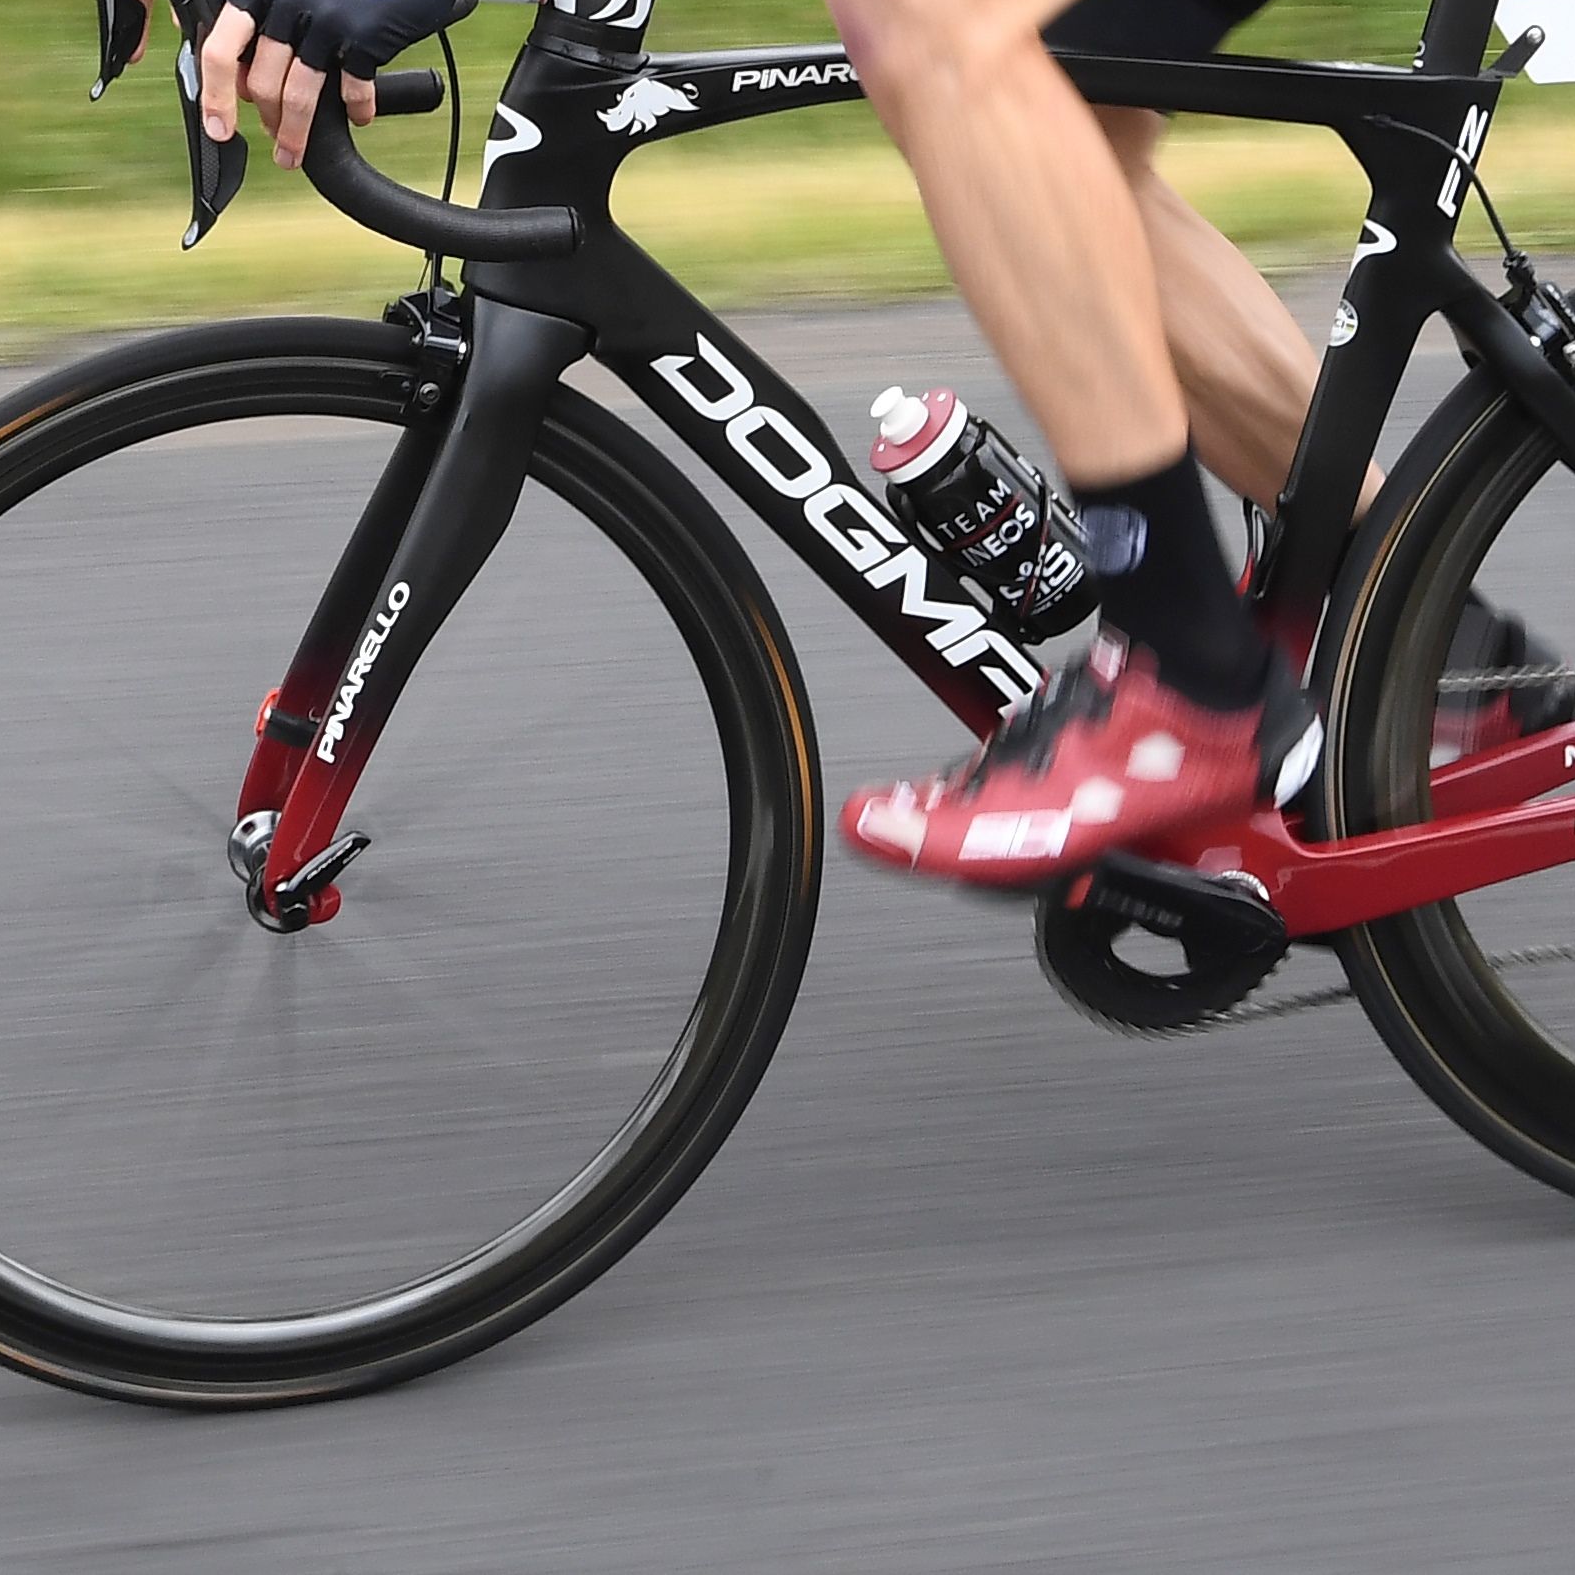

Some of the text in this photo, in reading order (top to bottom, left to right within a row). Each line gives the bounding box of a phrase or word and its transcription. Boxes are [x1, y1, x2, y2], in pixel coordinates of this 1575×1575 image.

[936, 477, 1013, 541] TEAM
[960, 502, 1036, 568] INEOS
[316, 580, 411, 765] PINARELLO
